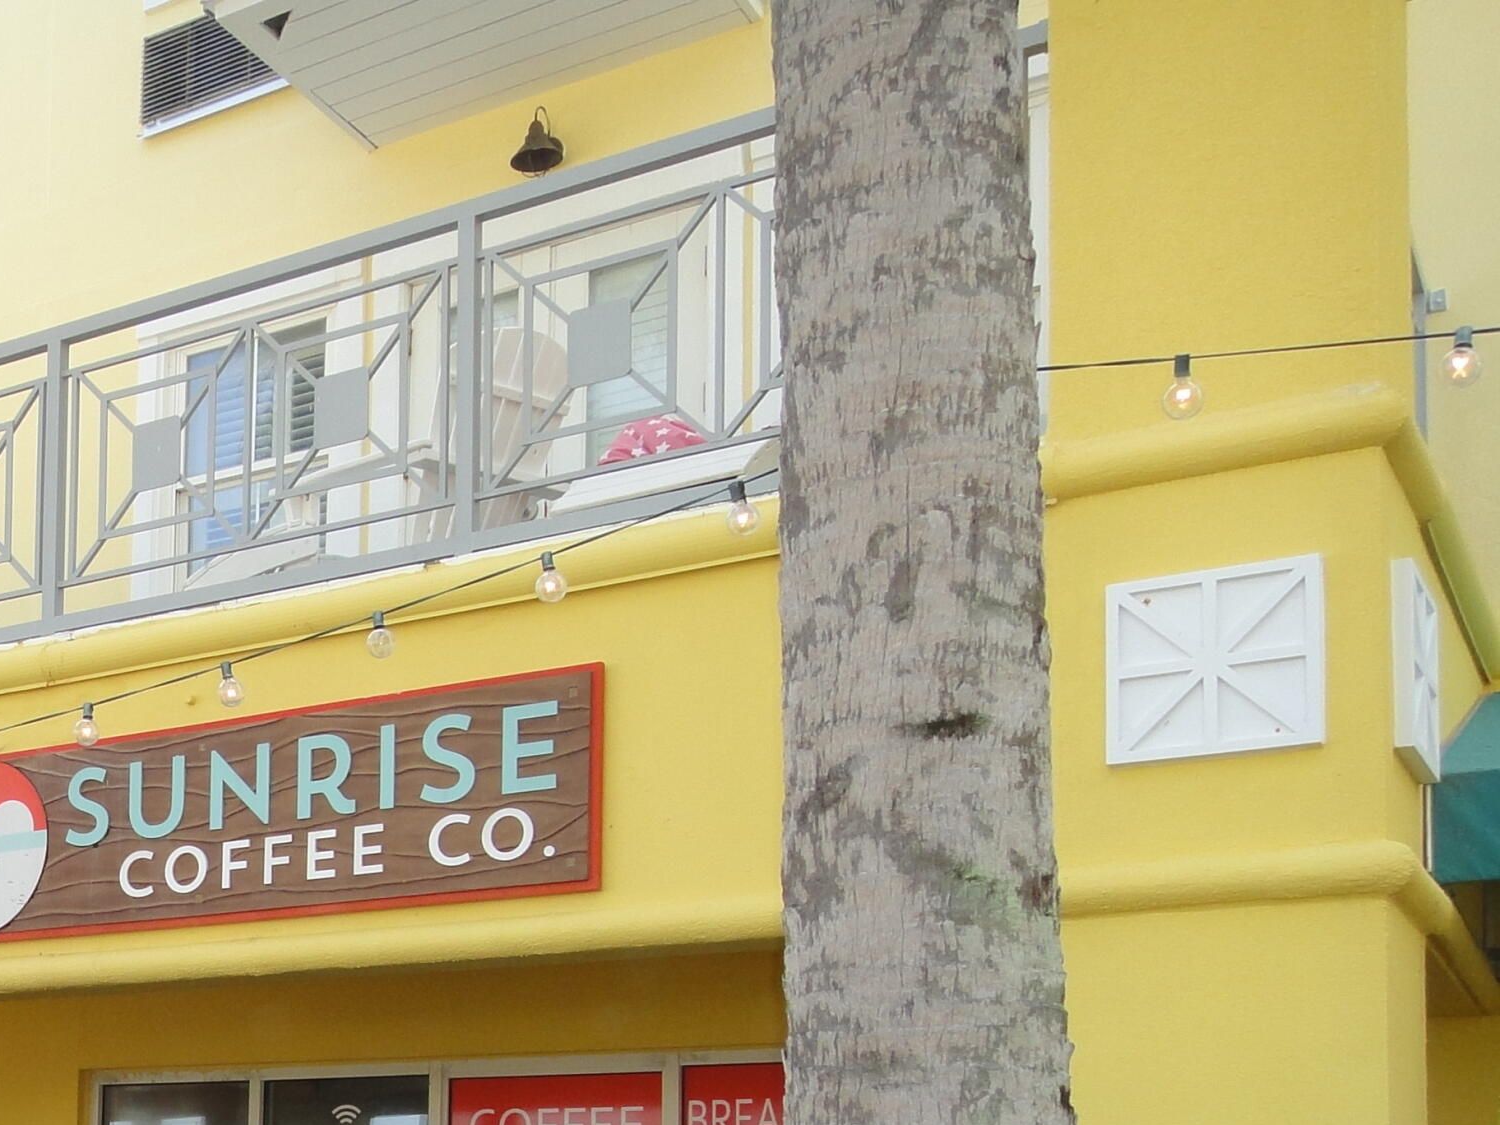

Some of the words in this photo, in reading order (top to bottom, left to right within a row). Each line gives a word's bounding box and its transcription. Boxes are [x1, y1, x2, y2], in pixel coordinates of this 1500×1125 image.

[65, 700, 560, 847] SUNRISE
[119, 823, 385, 898] COFFEE
[427, 807, 556, 867] CO.
